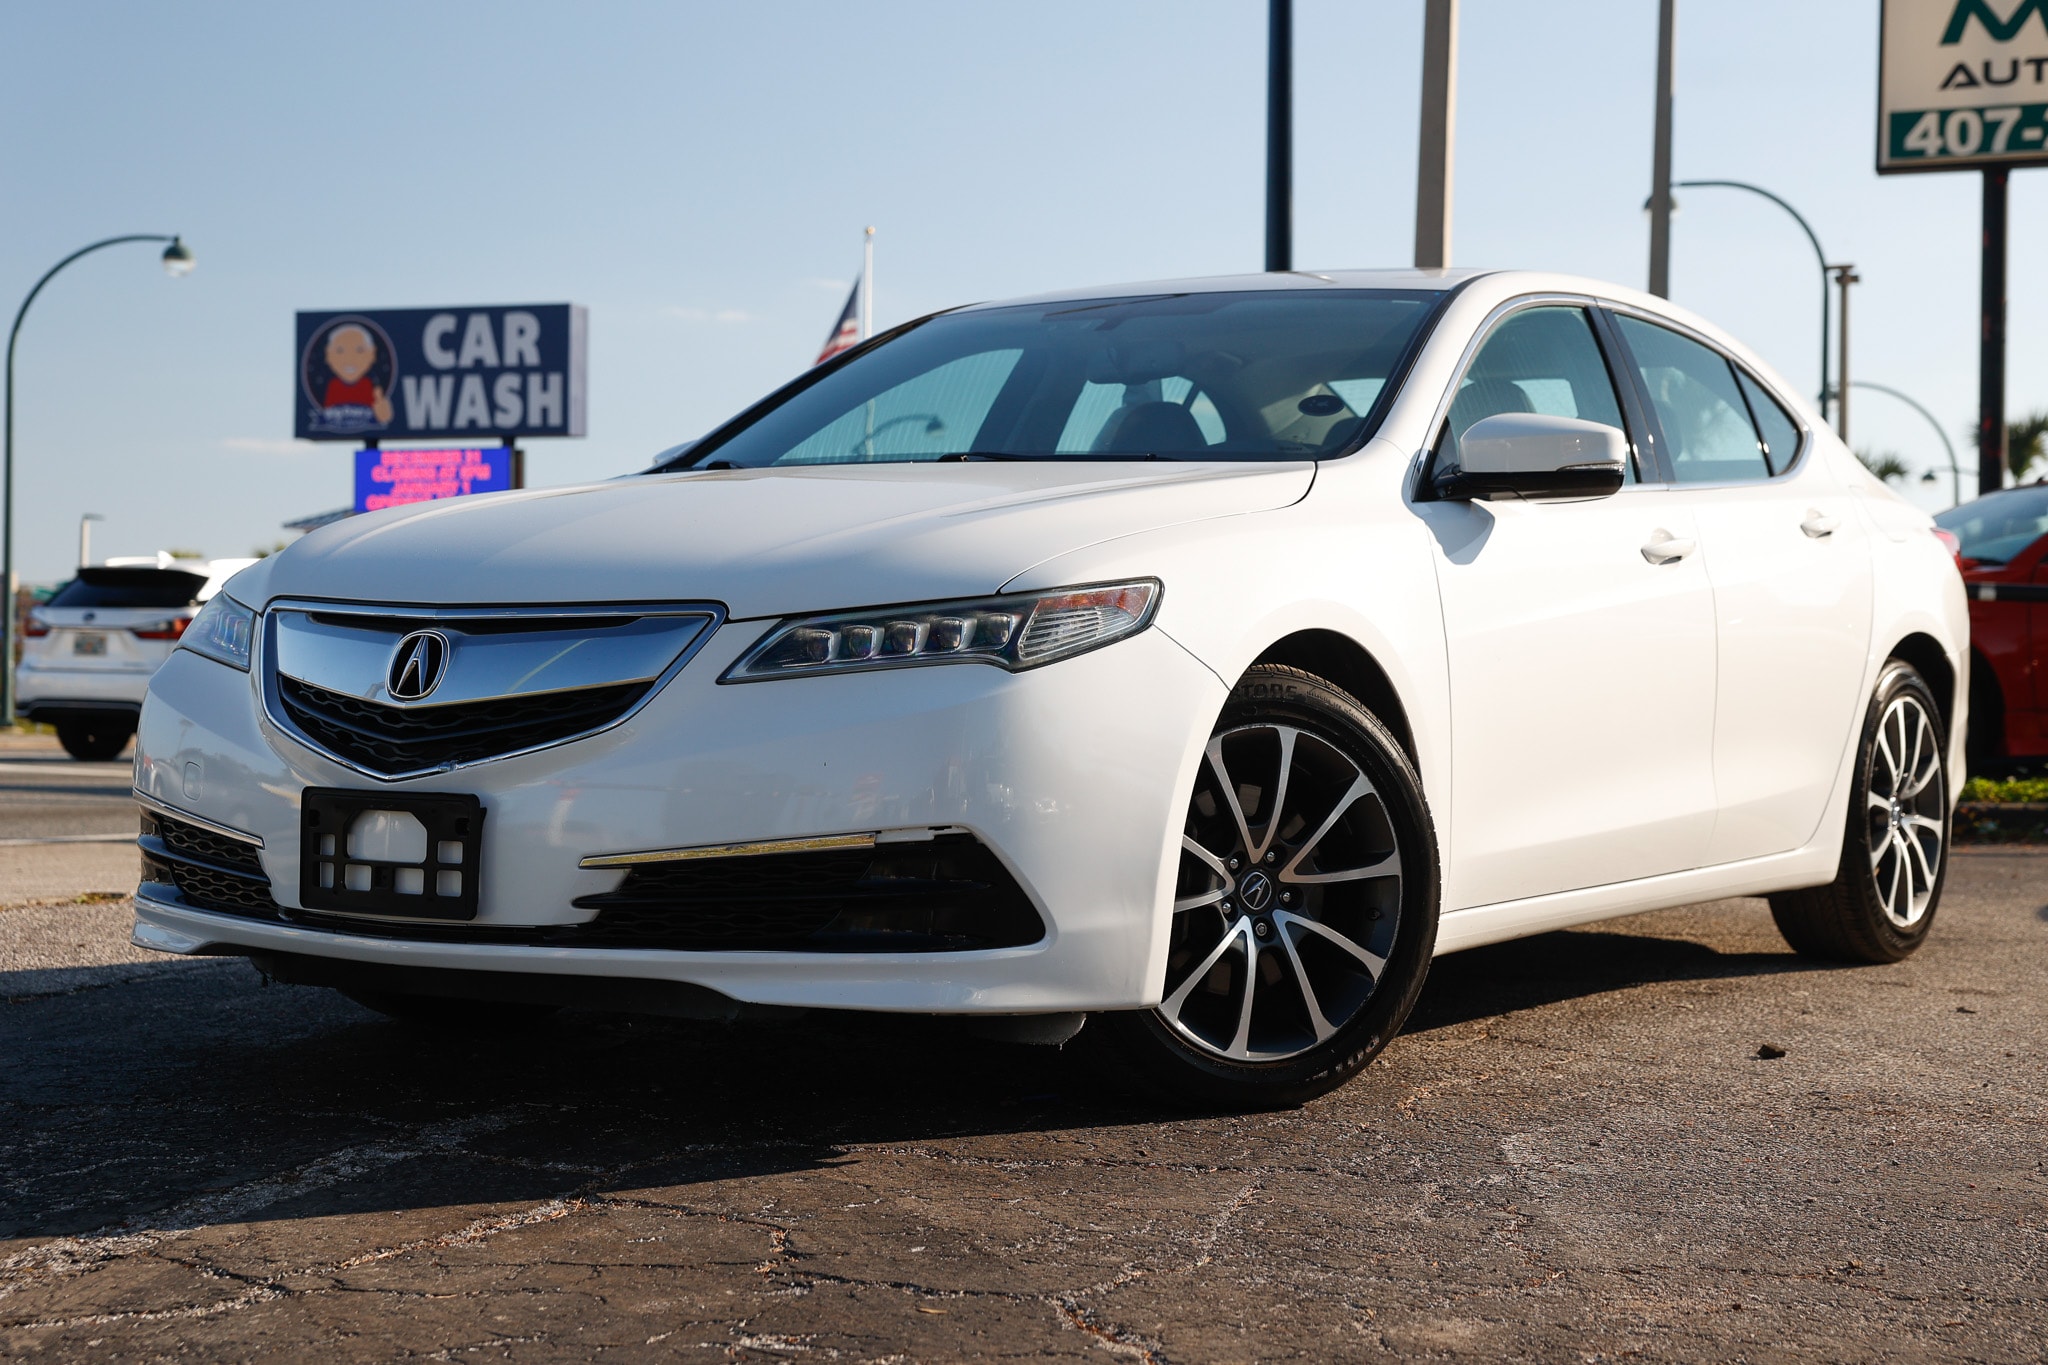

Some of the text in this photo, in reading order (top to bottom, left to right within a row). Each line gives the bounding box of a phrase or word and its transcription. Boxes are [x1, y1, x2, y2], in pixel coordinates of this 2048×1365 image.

[1903, 107, 2048, 157] 407-
[422, 311, 541, 369] CAR
[402, 372, 564, 429] WASH
